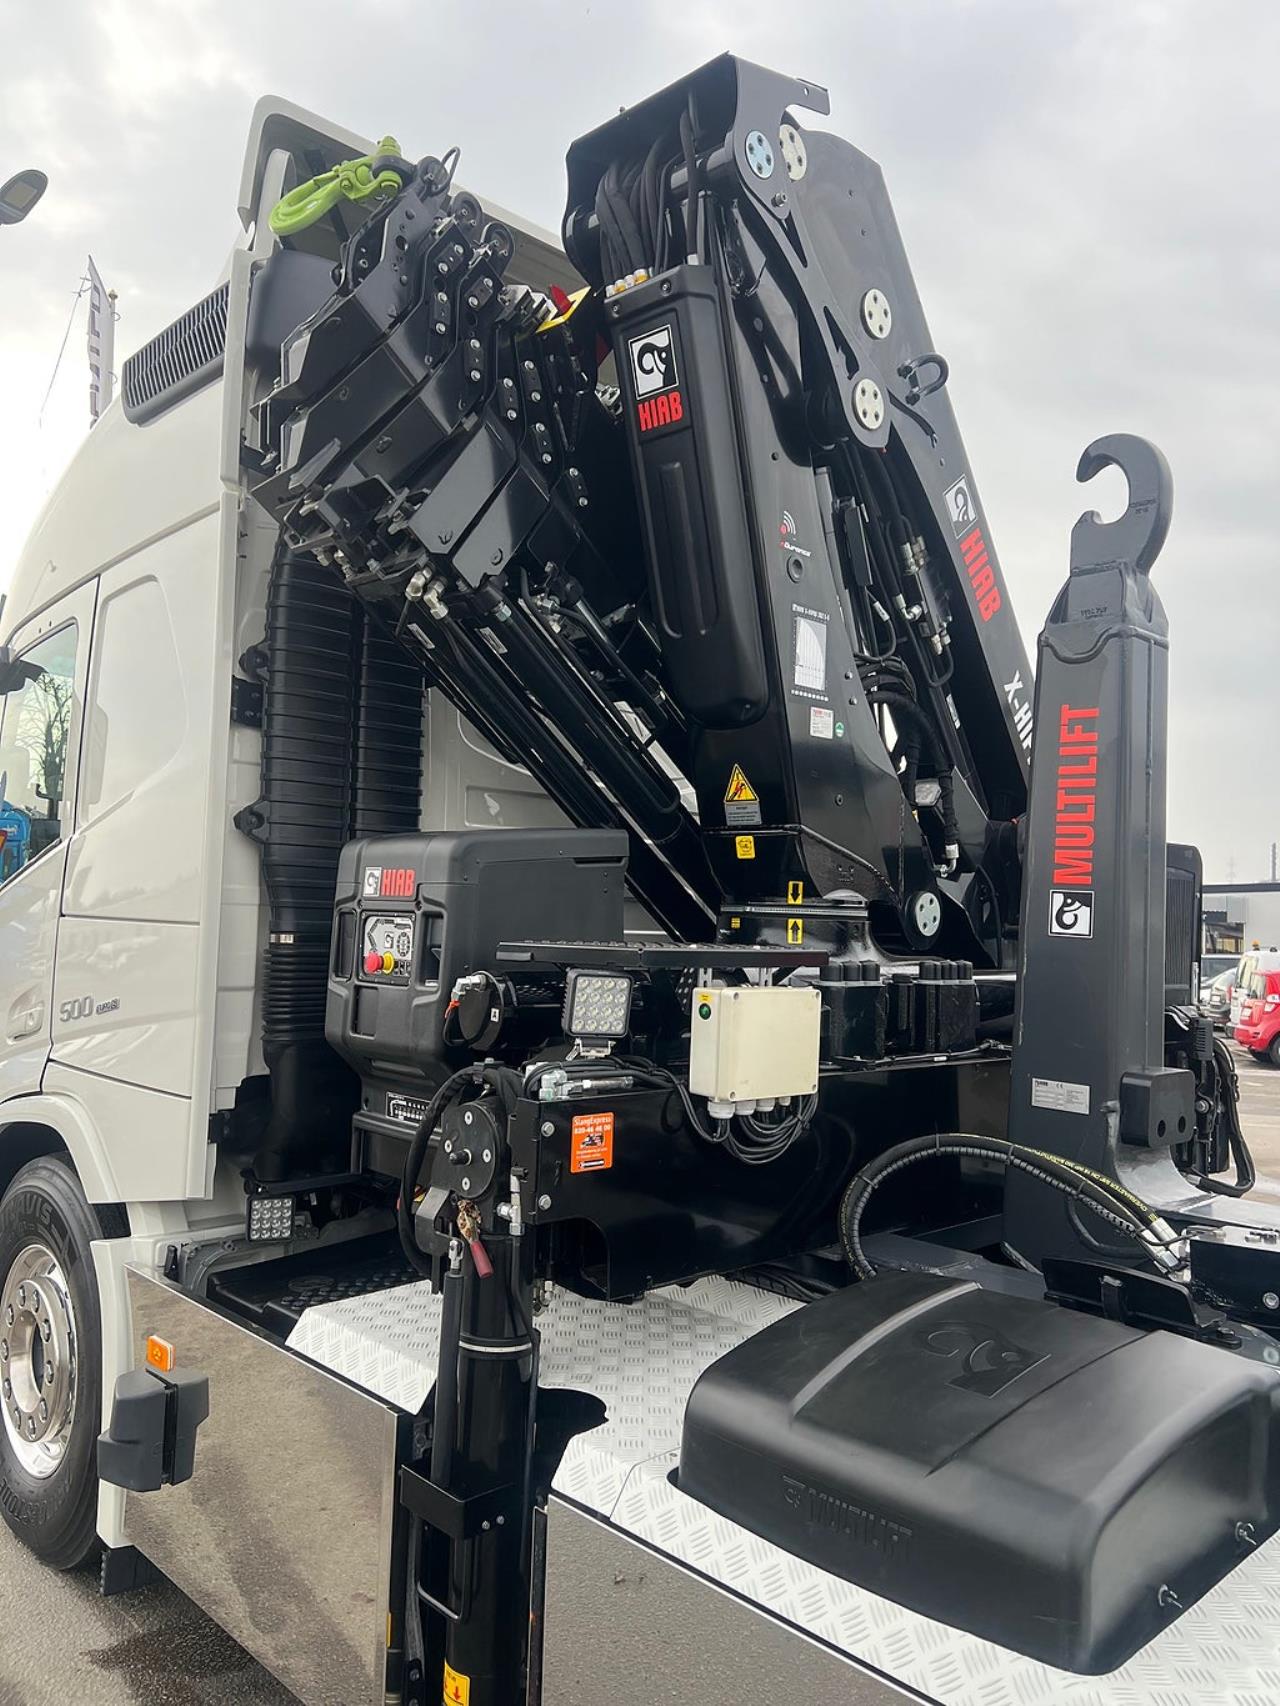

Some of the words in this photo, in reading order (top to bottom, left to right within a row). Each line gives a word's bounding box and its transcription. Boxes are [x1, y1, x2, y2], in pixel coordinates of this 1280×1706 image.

[637, 391, 683, 431] HIAB
[960, 528, 1001, 623] HIAB
[1053, 704, 1100, 885] MULTILIFT
[381, 868, 416, 897] HIAB
[60, 996, 94, 1022] 500
